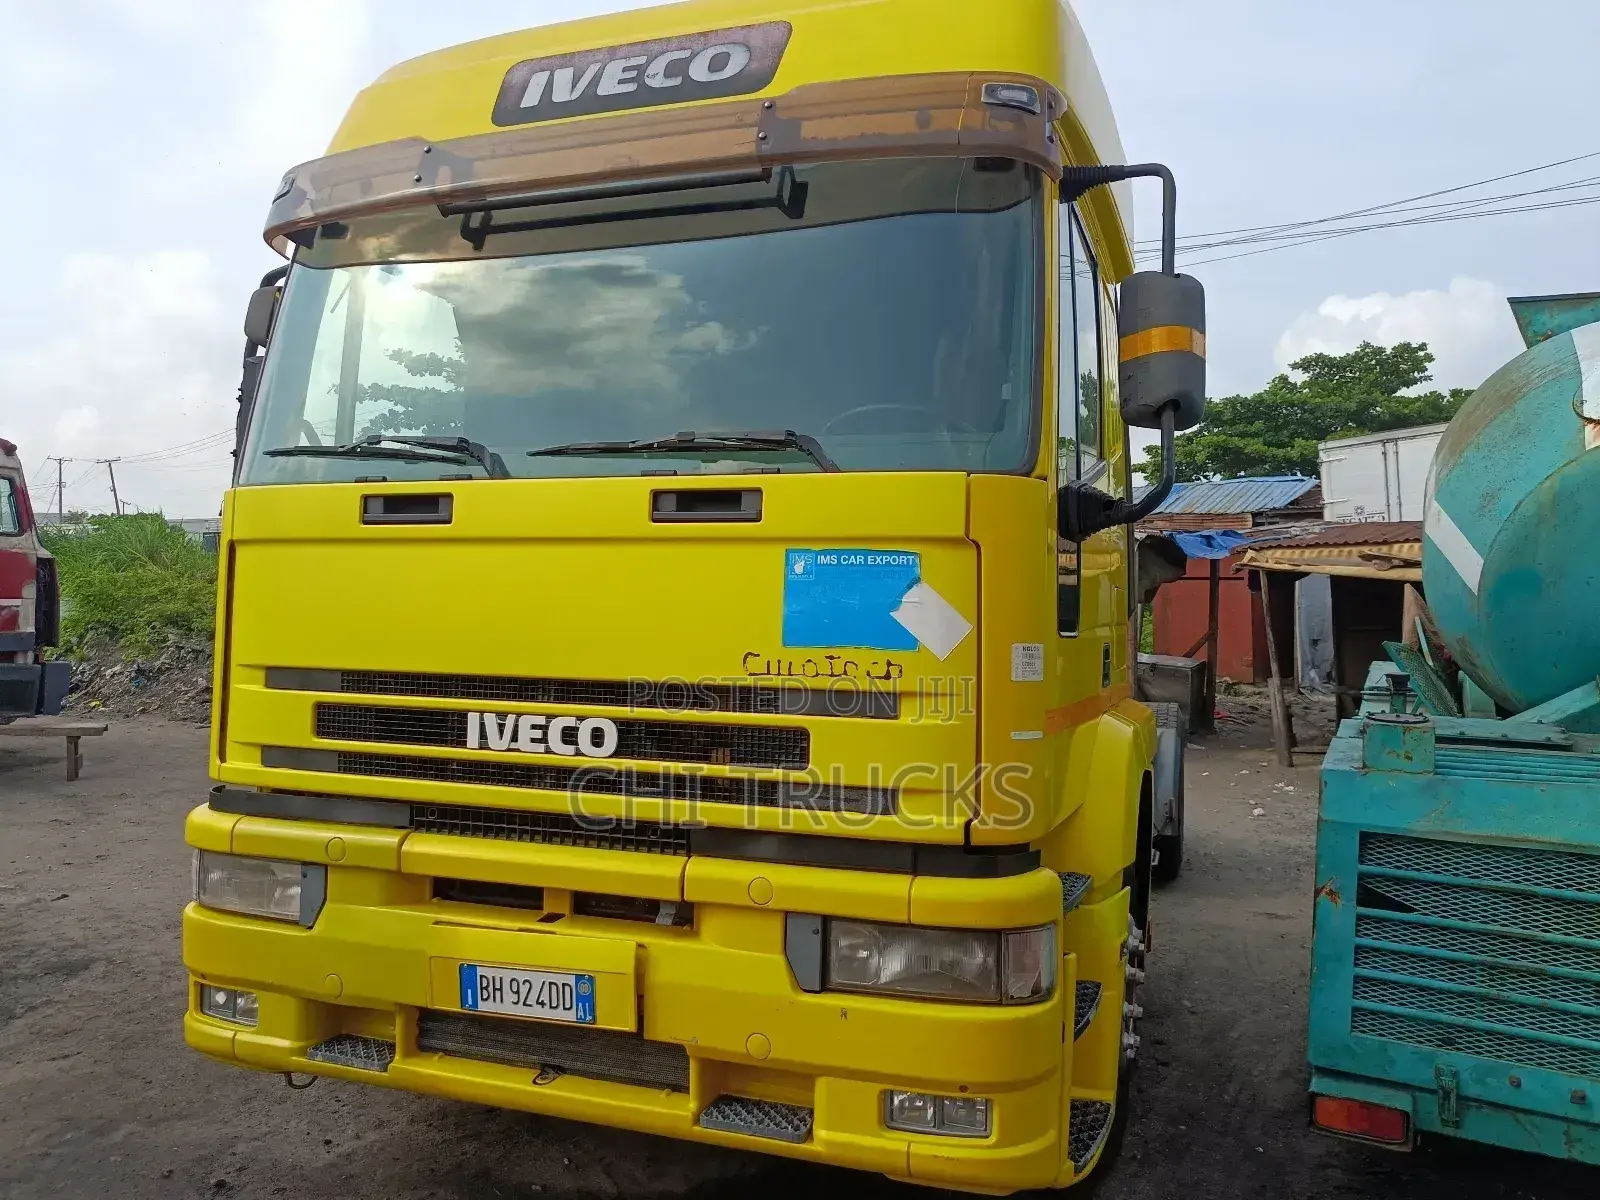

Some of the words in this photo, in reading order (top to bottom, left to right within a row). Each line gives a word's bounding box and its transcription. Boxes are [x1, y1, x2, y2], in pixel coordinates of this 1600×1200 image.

[519, 41, 751, 109] IVECO
[817, 555, 838, 565] IMS
[840, 555, 865, 565] CAR
[867, 555, 915, 566] EXPORT
[466, 711, 619, 758] IVECO
